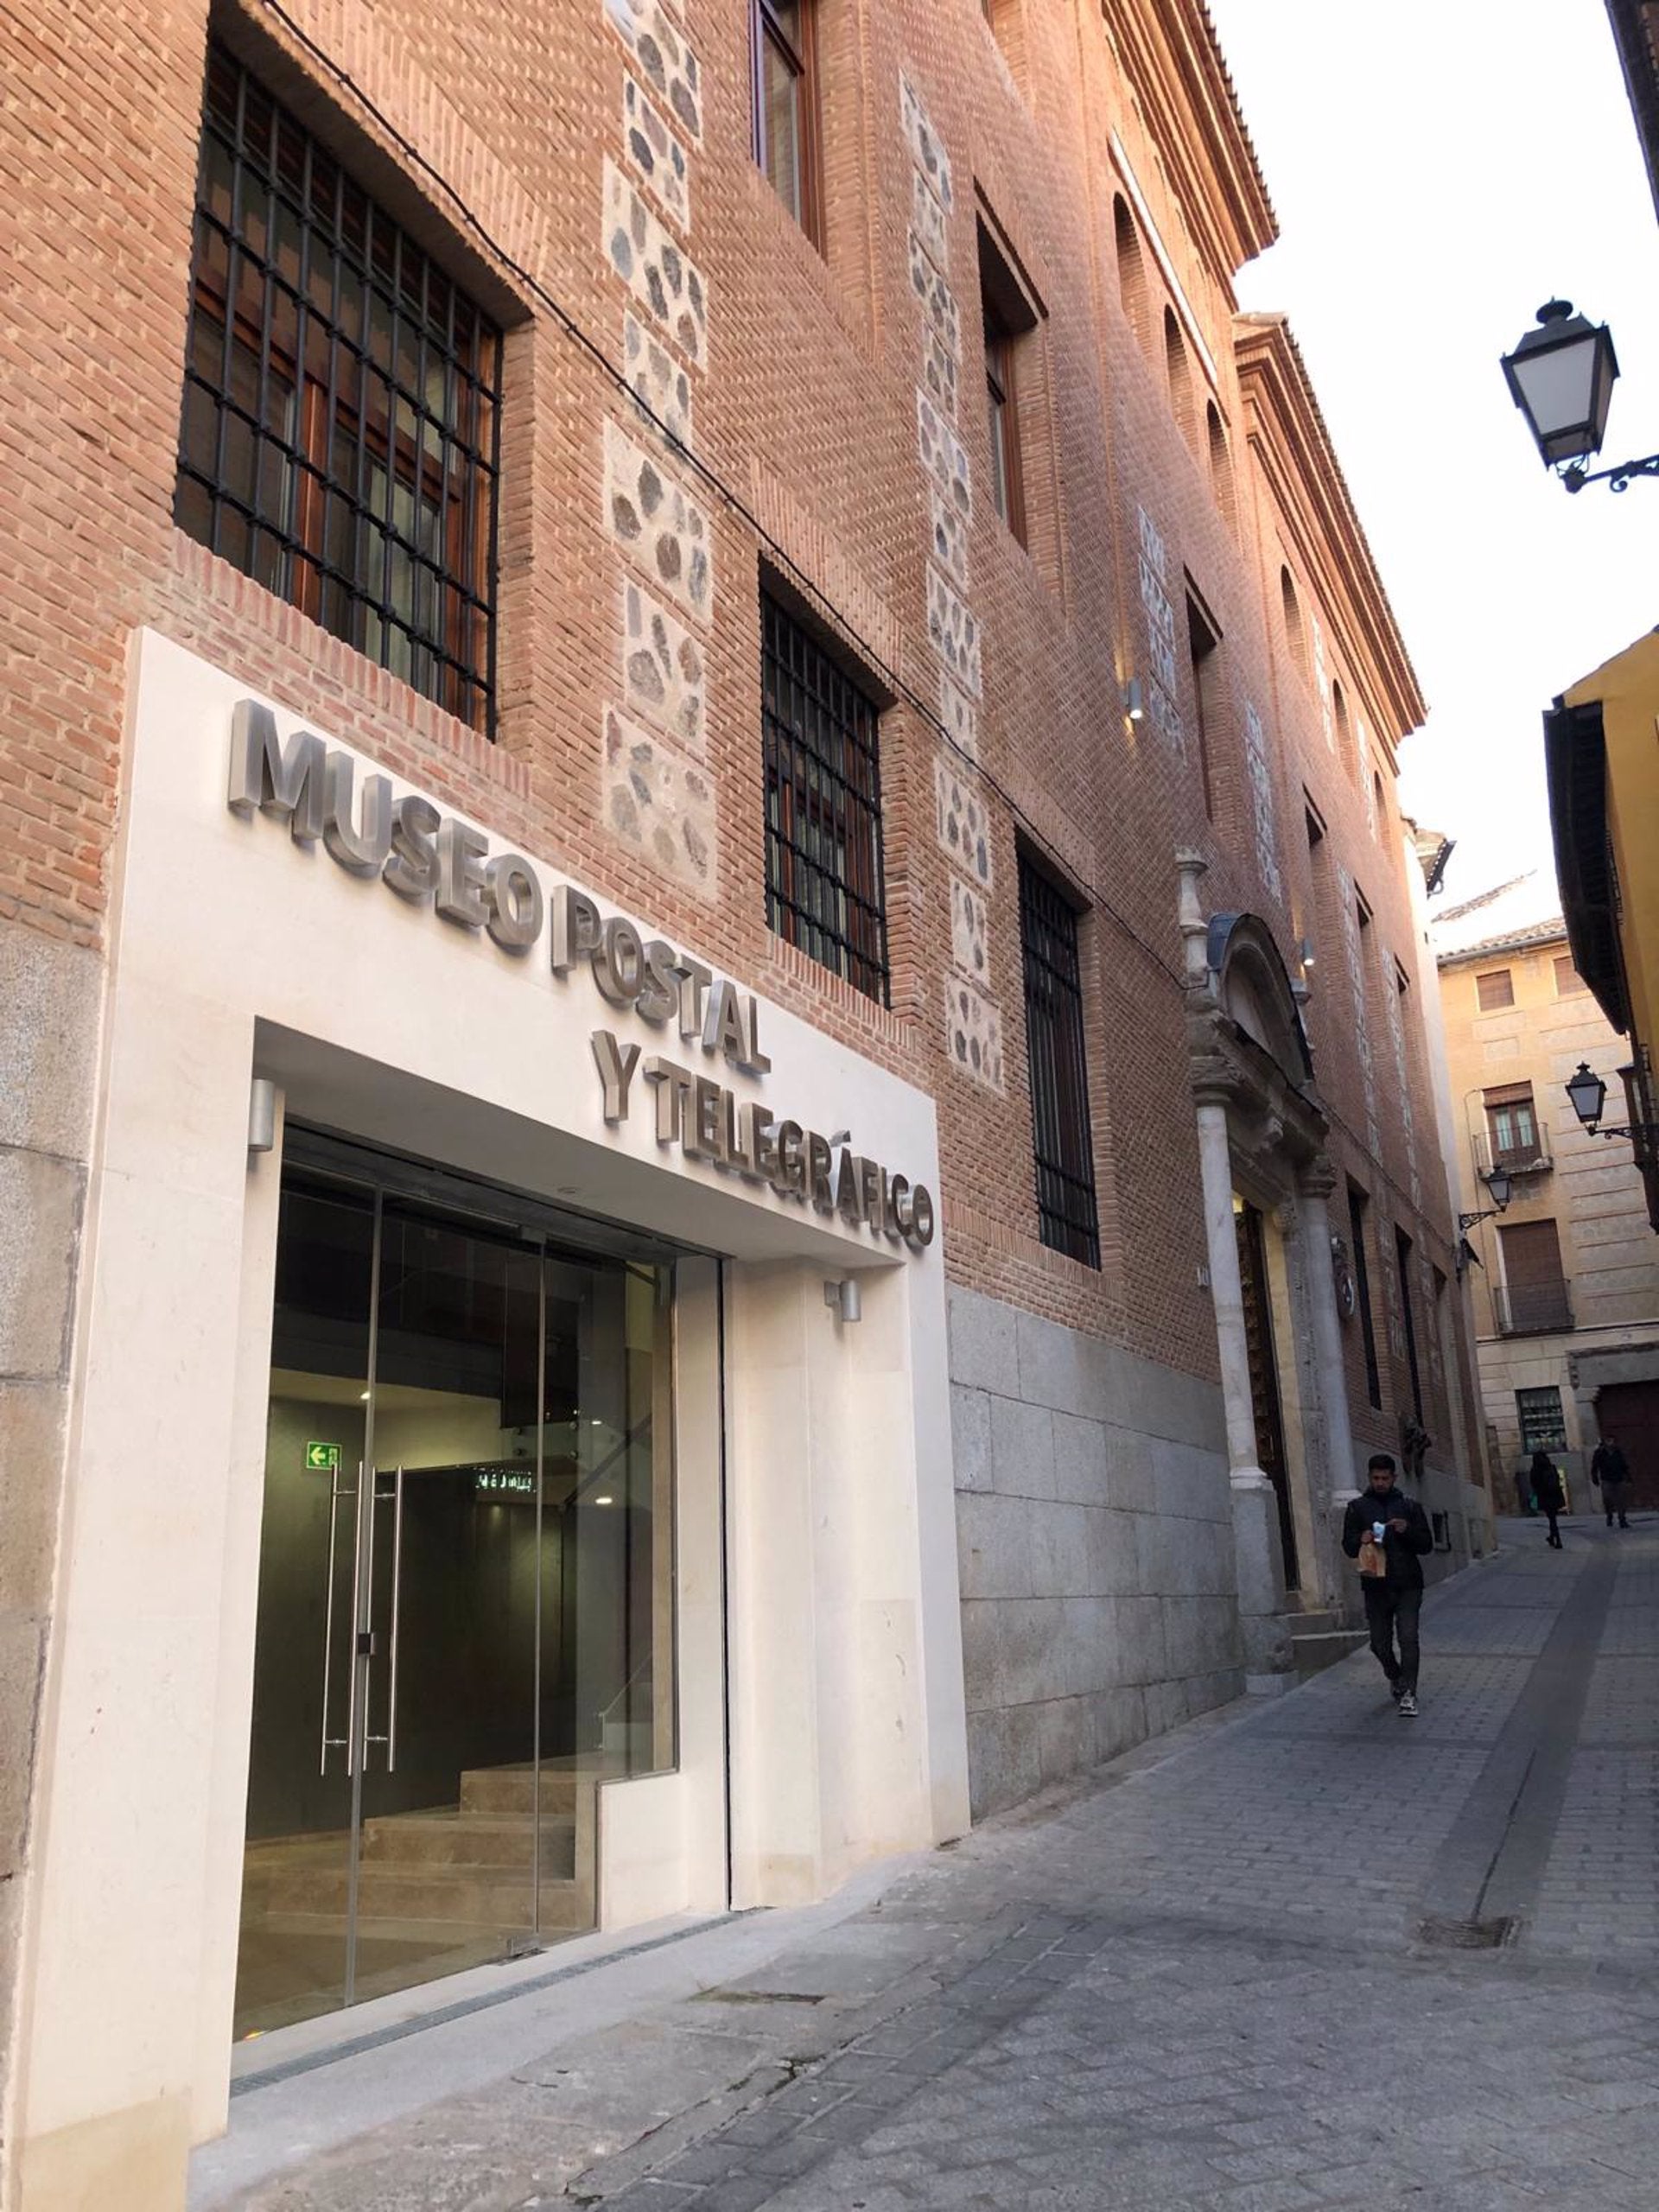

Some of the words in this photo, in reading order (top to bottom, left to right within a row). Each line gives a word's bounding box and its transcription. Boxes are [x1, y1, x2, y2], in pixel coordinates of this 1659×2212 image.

[229, 699, 544, 948] MUSEO
[550, 884, 772, 1075] POSTAL
[591, 1030, 640, 1122] Y
[643, 1056, 934, 1249] TELEGRÁFICO
